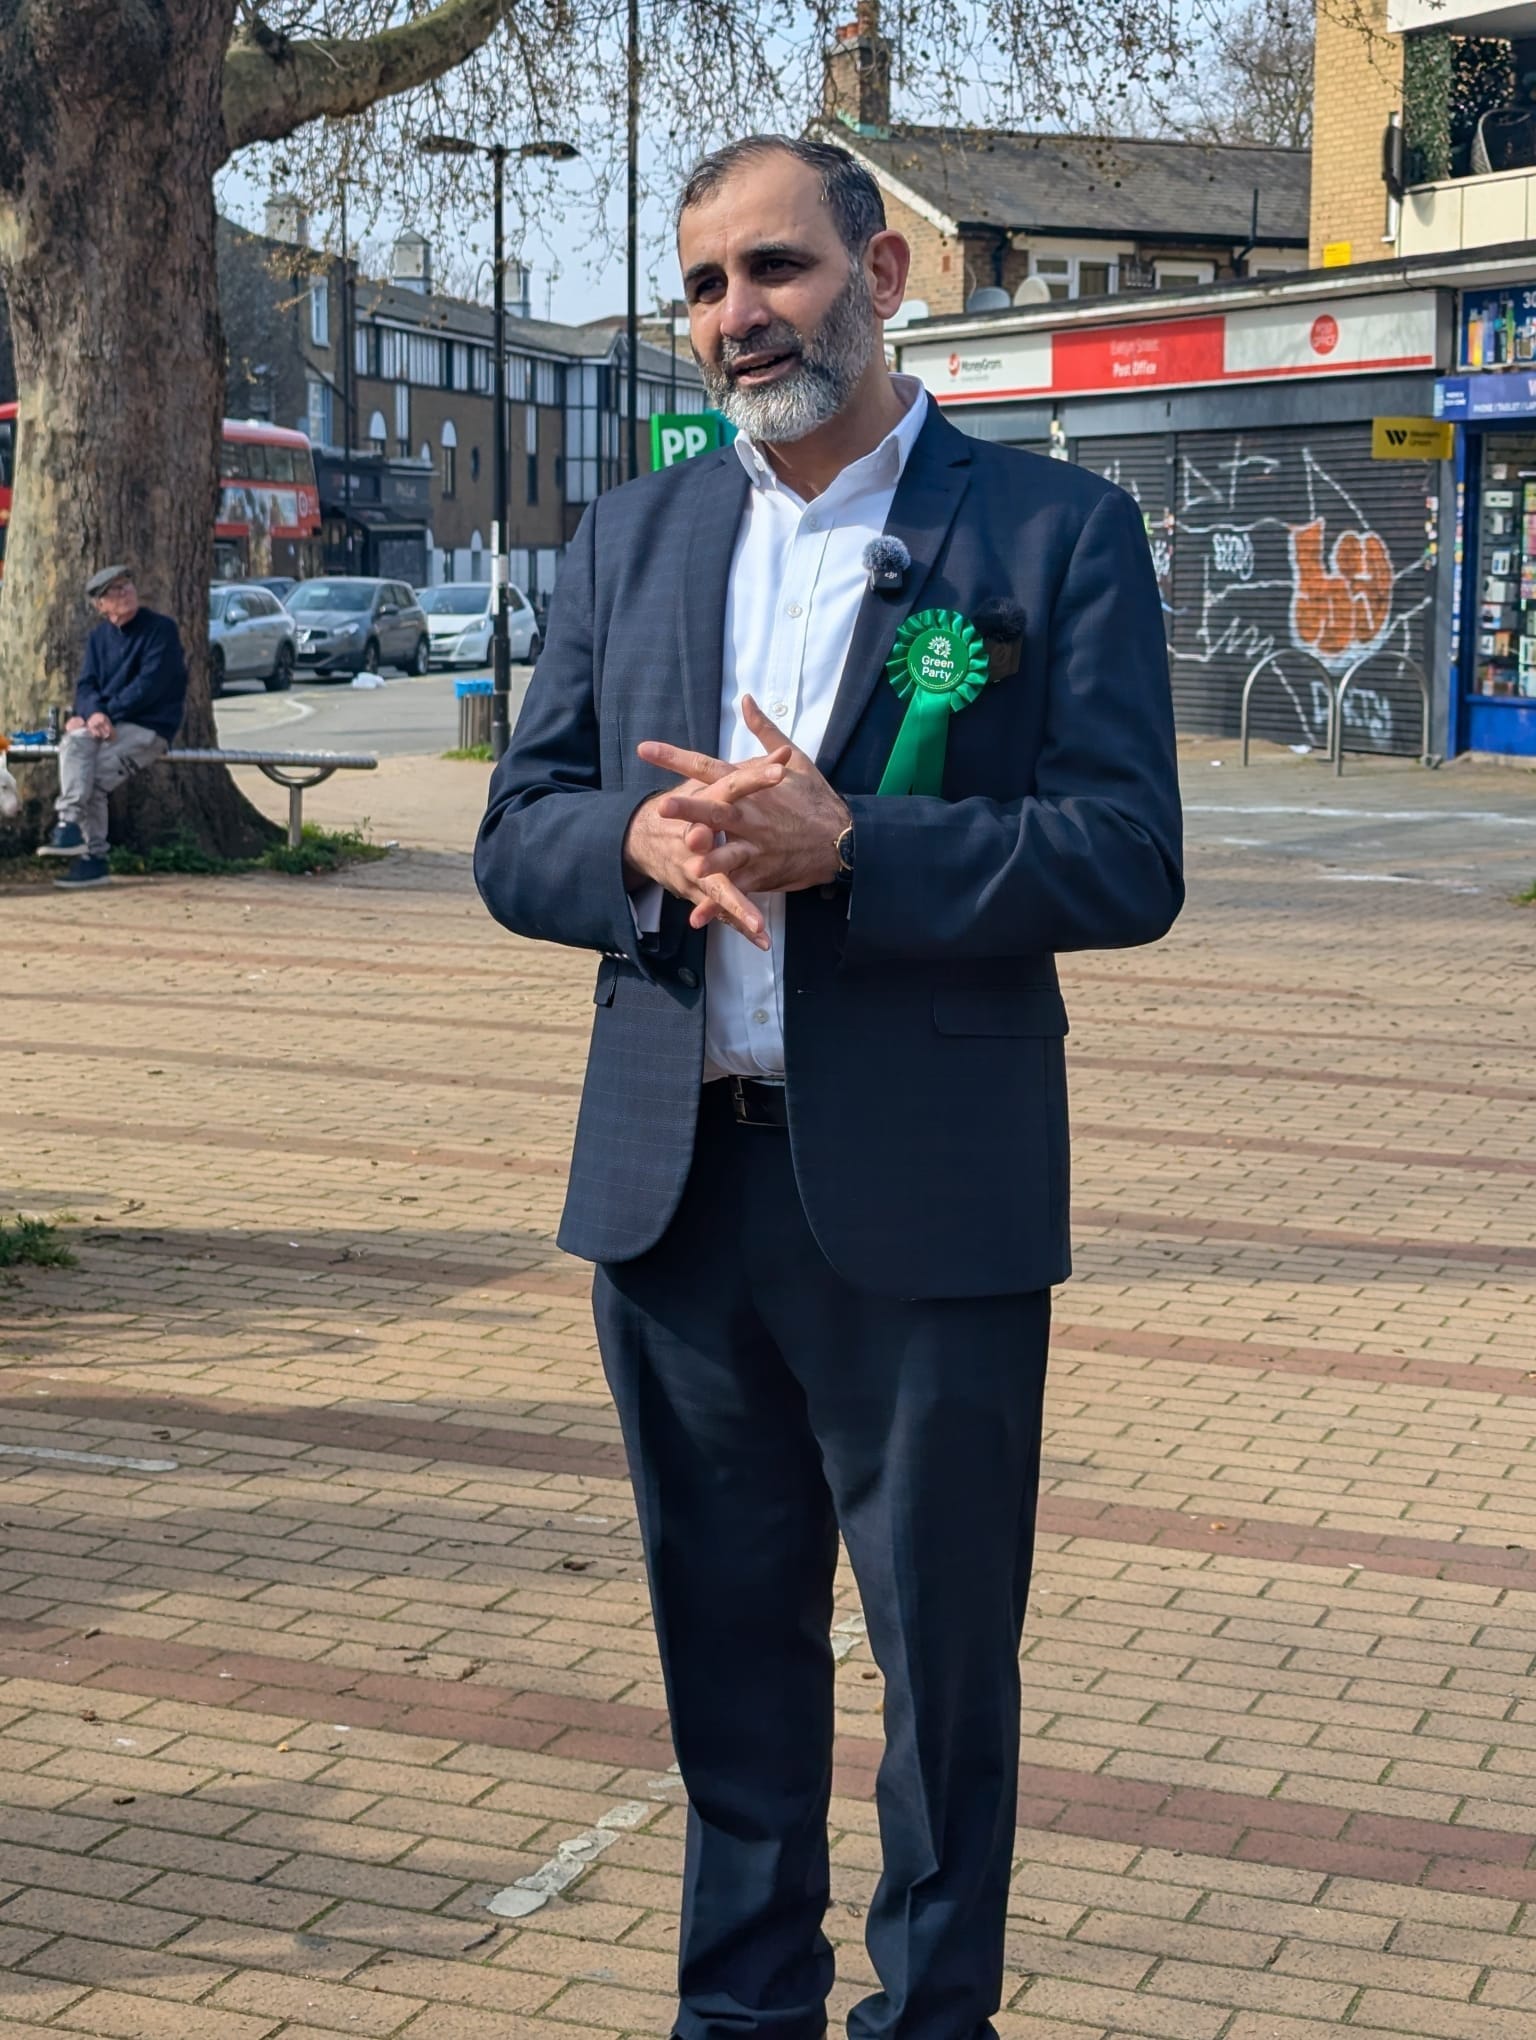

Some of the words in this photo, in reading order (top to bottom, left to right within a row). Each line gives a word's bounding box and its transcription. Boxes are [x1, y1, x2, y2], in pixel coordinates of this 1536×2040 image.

[961, 358, 1003, 374] MoneyGram
[1113, 362, 1132, 378] Post
[1132, 359, 1157, 376] Office
[921, 655, 954, 669] Green
[921, 667, 952, 682] Party
